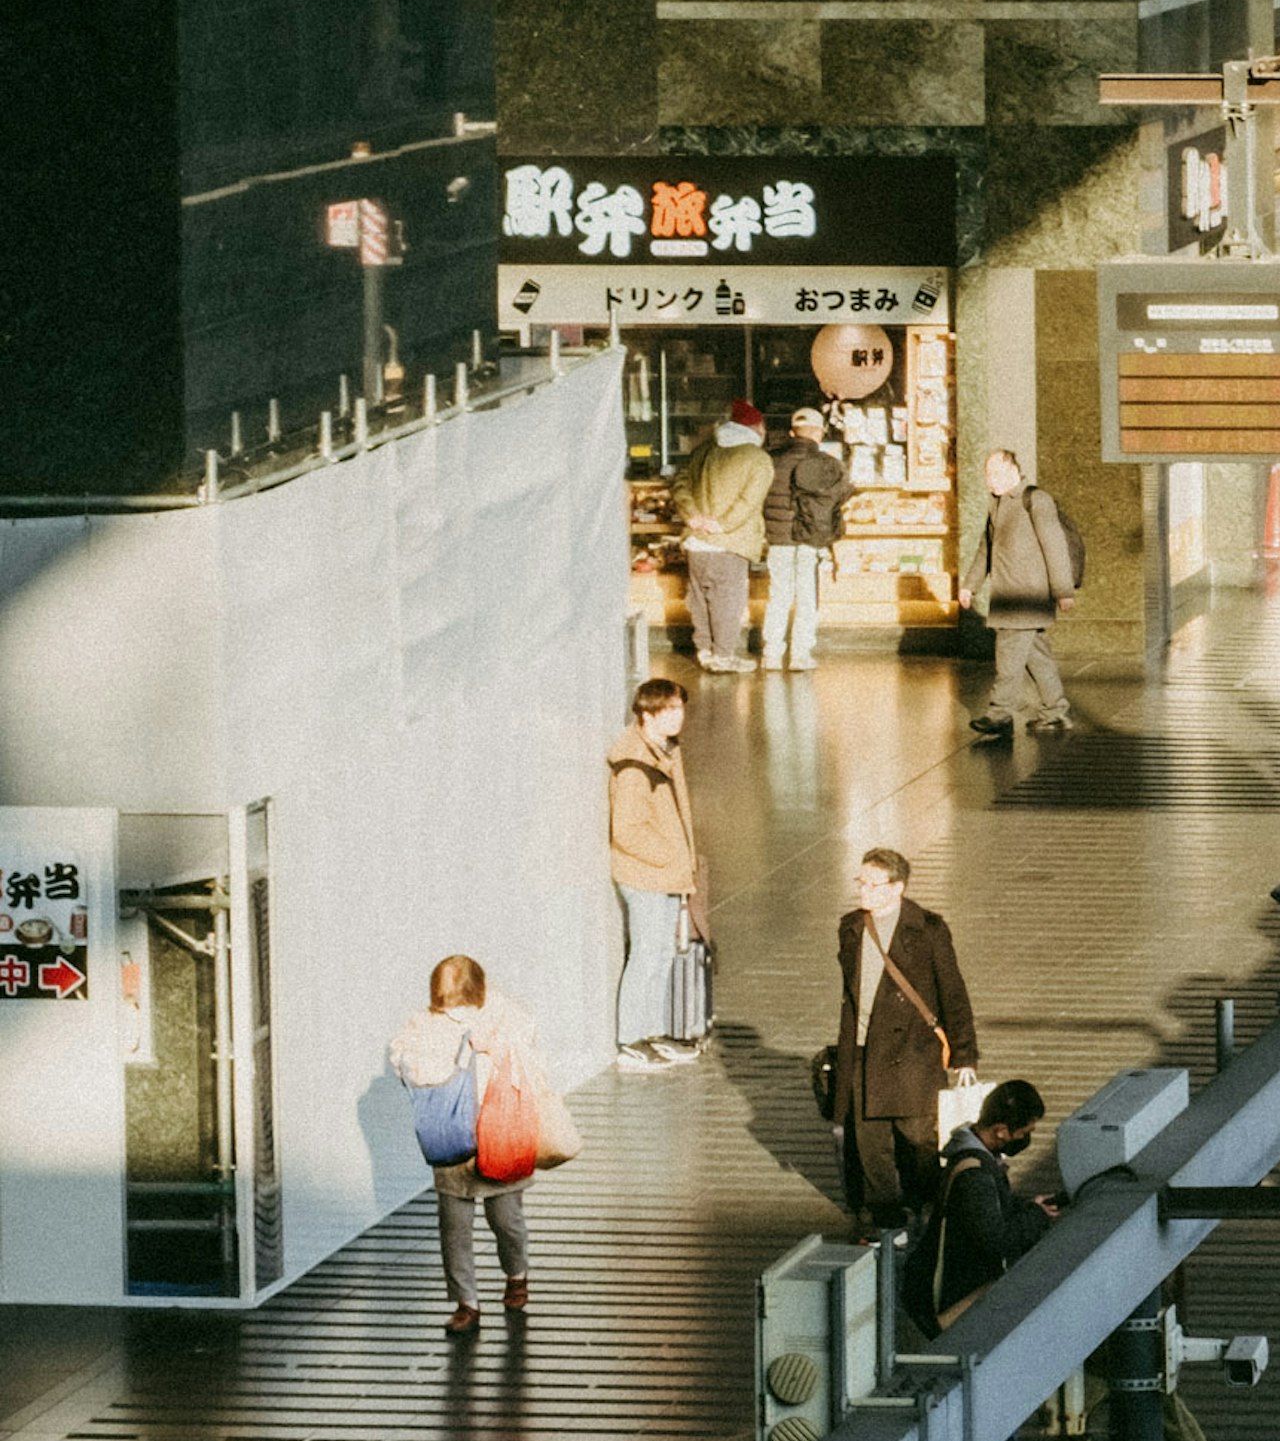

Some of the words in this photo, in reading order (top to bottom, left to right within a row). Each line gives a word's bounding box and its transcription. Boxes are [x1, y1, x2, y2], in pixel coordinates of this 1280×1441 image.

[606, 287, 703, 311] ドリンク
[795, 287, 899, 312] おつまみ
[0, 862, 80, 910] 弁当
